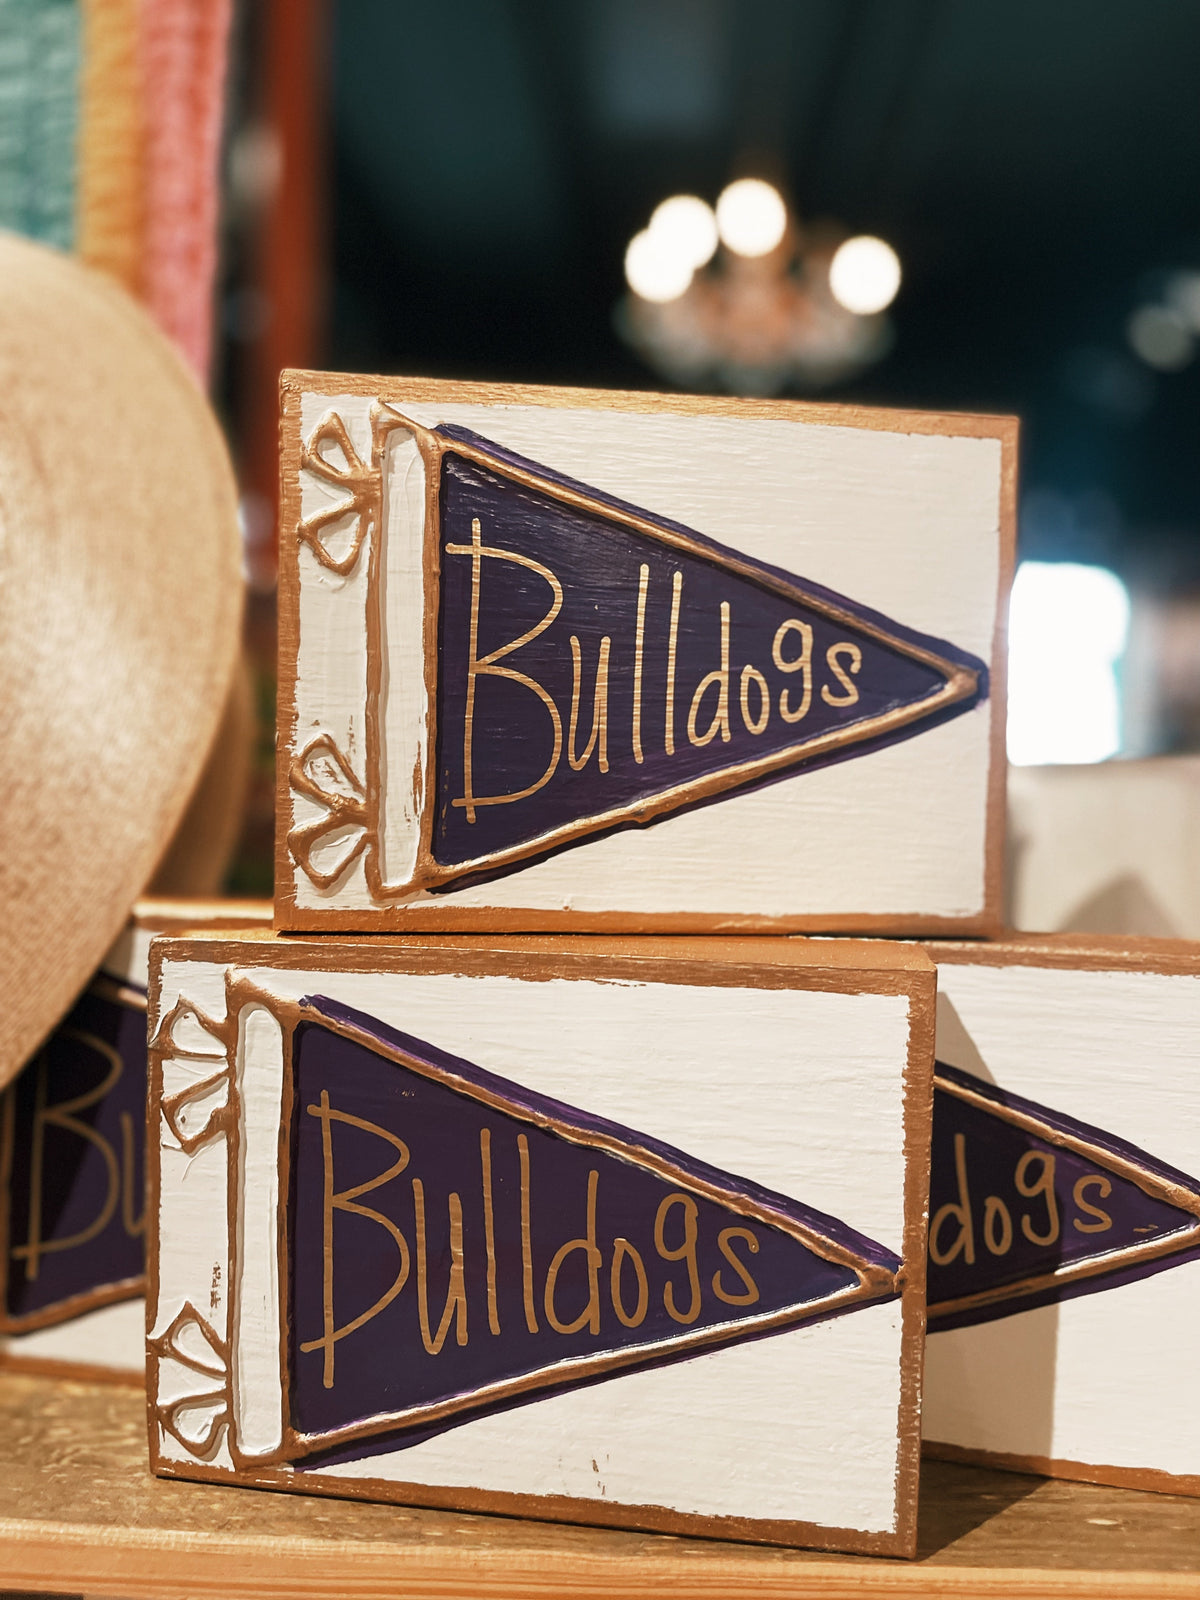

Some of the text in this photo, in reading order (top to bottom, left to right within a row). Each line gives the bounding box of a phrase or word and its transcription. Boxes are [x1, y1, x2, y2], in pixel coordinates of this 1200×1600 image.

[445, 518, 862, 824] Bulldogs
[300, 1089, 760, 1389] Bulldogs
[929, 1133, 1113, 1265] dogs
